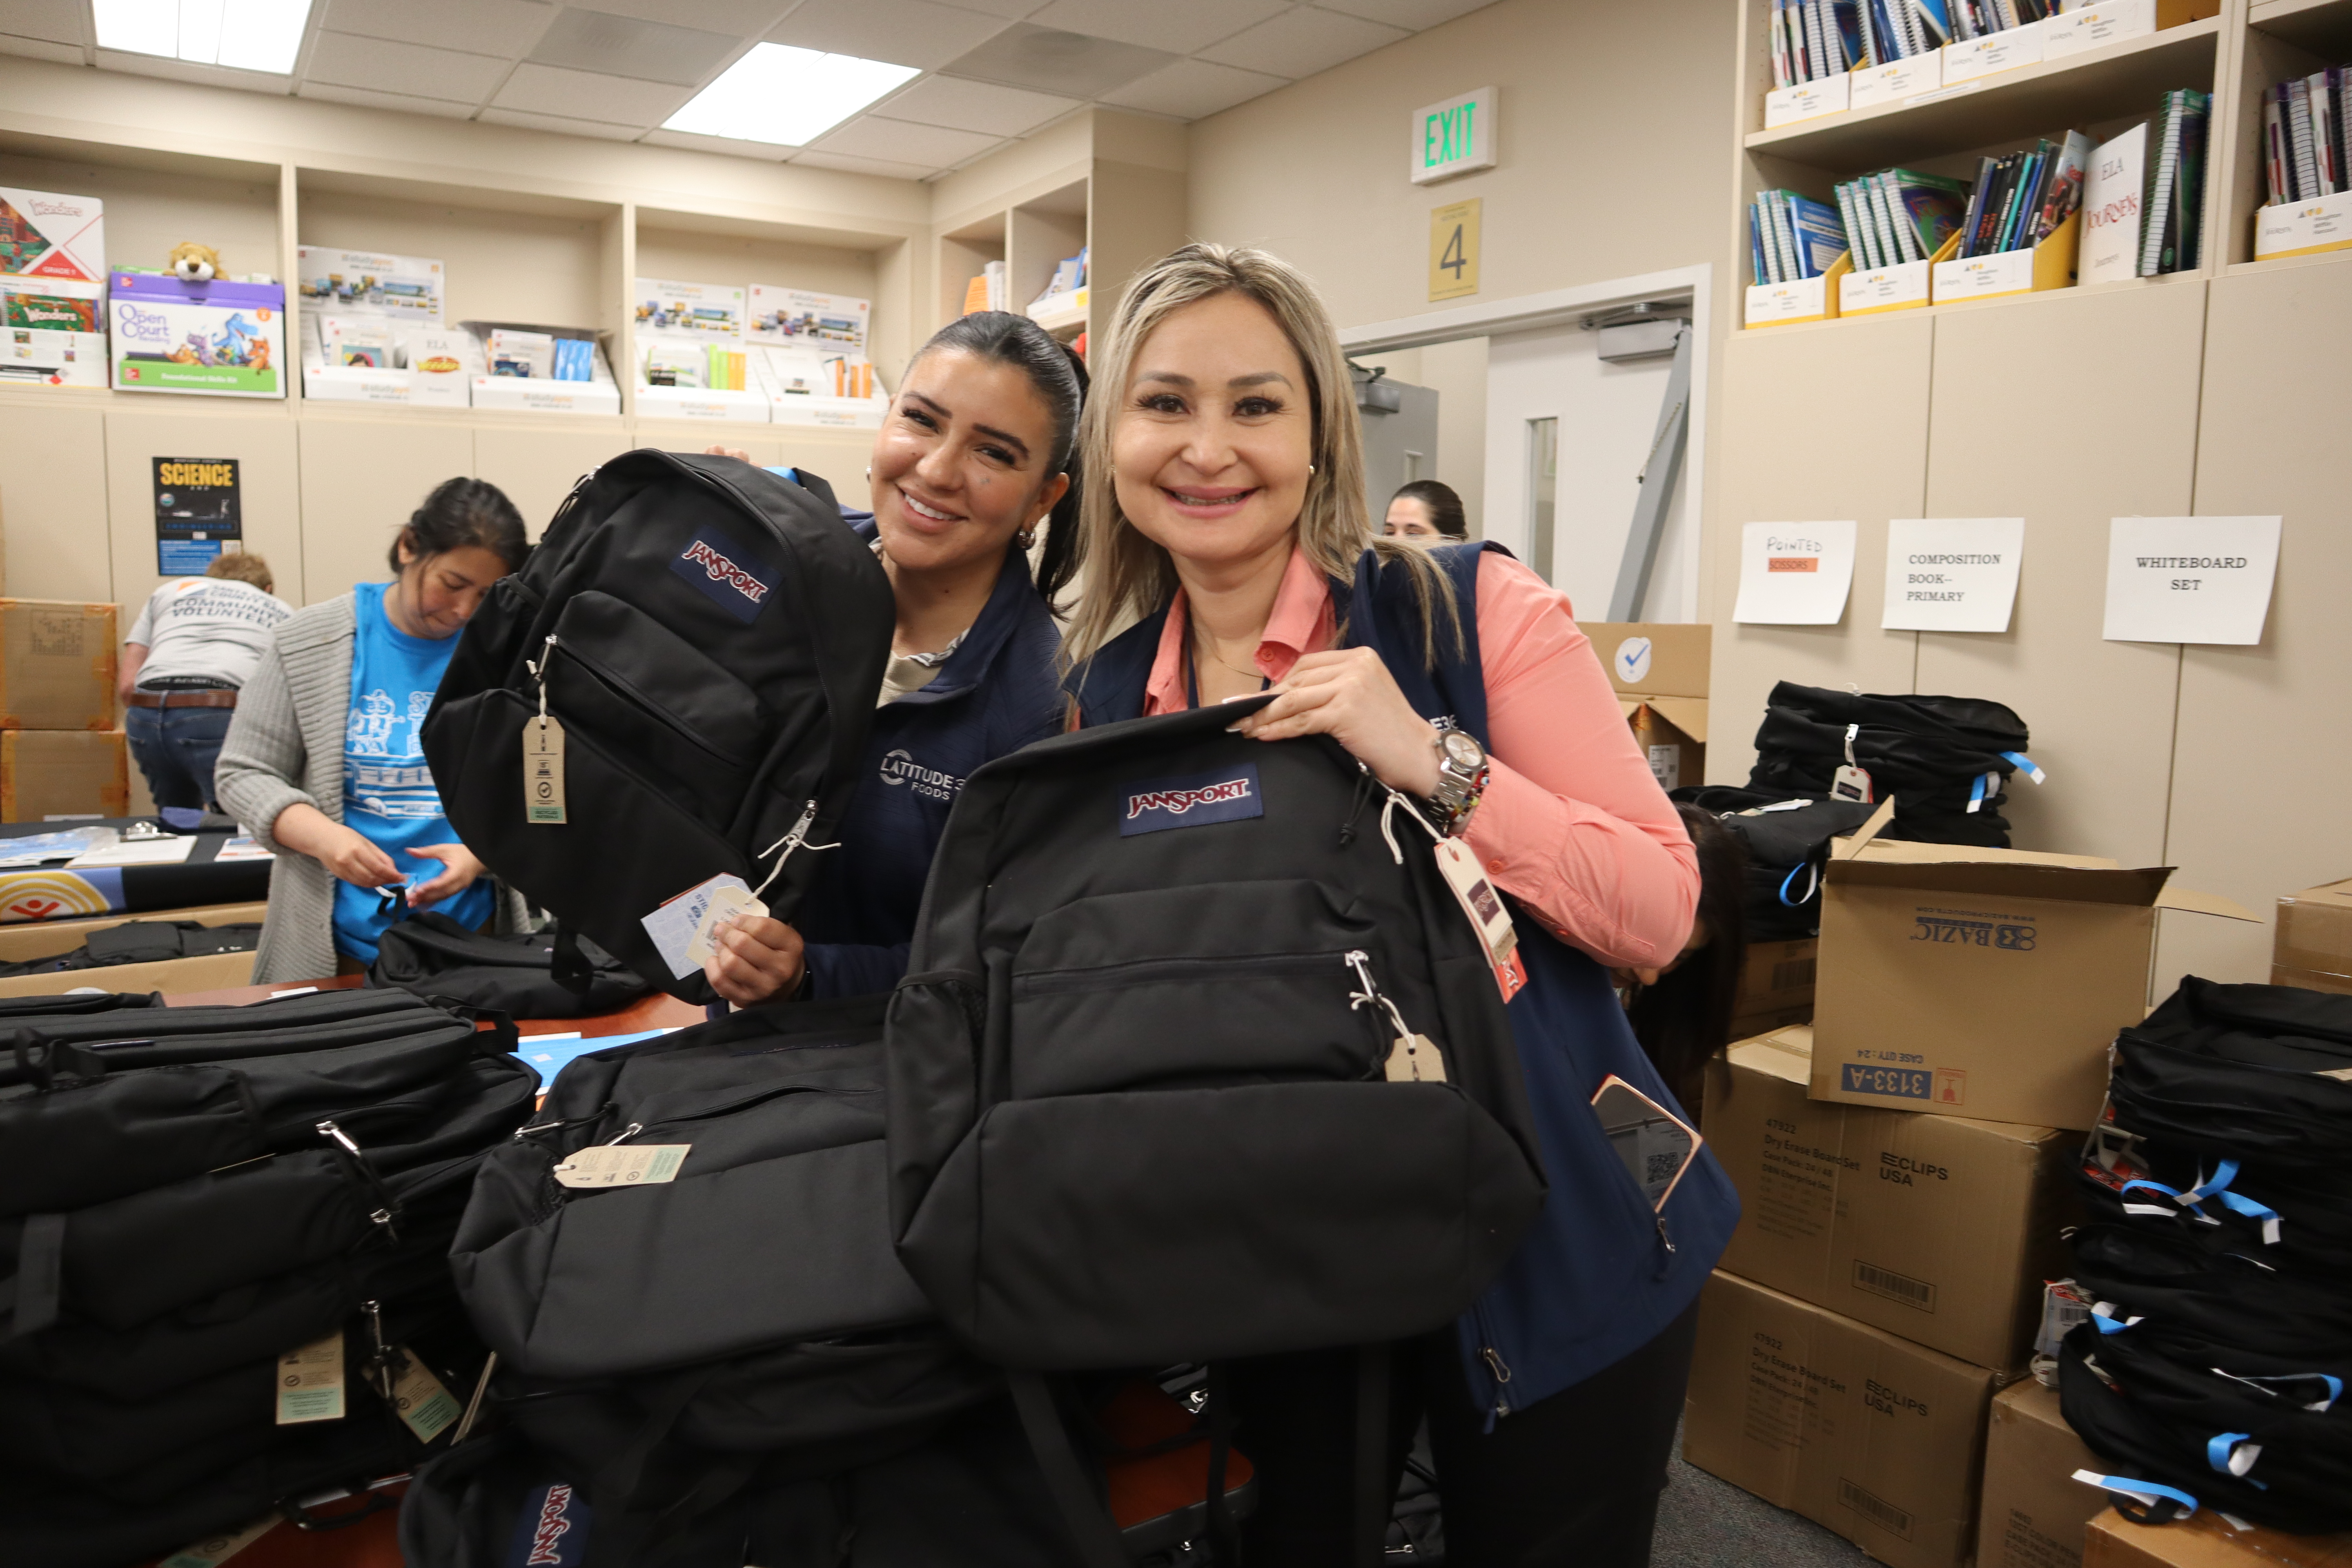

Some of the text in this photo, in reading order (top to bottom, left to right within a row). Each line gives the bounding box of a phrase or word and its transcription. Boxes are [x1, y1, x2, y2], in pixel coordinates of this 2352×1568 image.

[1425, 102, 1477, 168] EXIT
[1439, 223, 1467, 279] 4
[119, 303, 167, 325] Open
[122, 320, 170, 337] Court
[160, 463, 233, 486] SCIENCE
[1769, 560, 1808, 569] SCISSORS
[1909, 554, 2001, 564] COMPOSITION
[2136, 558, 2247, 568] WHITEBOARD
[681, 540, 769, 603] JANSPORT
[1906, 592, 1964, 601] PRIMARY
[2171, 580, 2201, 590] SET
[880, 757, 955, 789] LATITUDE
[911, 782, 951, 800] FOODS
[1127, 778, 1249, 819] JANSPORT
[1915, 923, 1990, 947] BAZIC
[1857, 1049, 1870, 1058] 24
[1899, 1053, 1924, 1064] CASE
[1849, 1067, 1924, 1095] 3133-A
[1765, 1134, 1860, 1171] Dry Erase Board Set
[1880, 1167, 1913, 1187] USA
[1881, 1152, 1948, 1181] ECLIPS
[1753, 1347, 1846, 1393] Dry Erase Board Set
[1864, 1393, 1895, 1417] USA
[526, 1484, 572, 1566] JANSPORT
